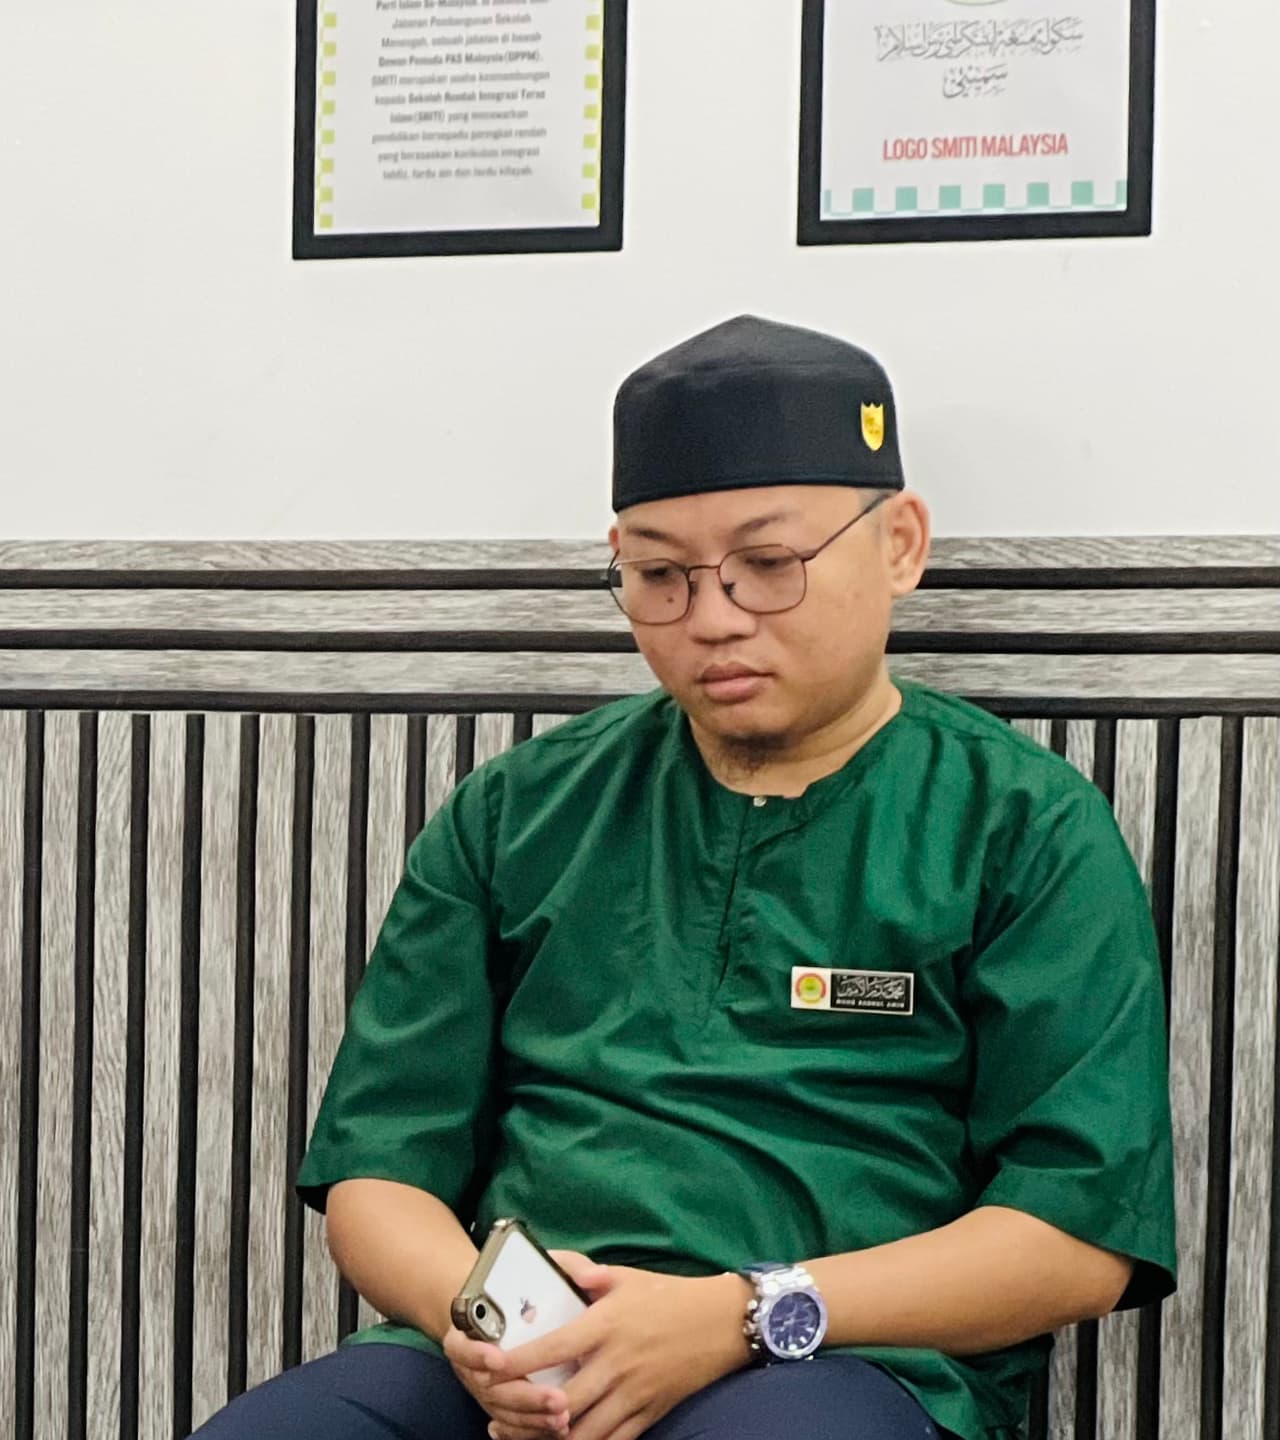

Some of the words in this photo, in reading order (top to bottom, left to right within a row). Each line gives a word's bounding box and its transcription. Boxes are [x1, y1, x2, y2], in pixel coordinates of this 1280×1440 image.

[882, 138, 928, 161] LOGO
[931, 136, 978, 159] SMITI
[981, 133, 1068, 158] MALAYSIA
